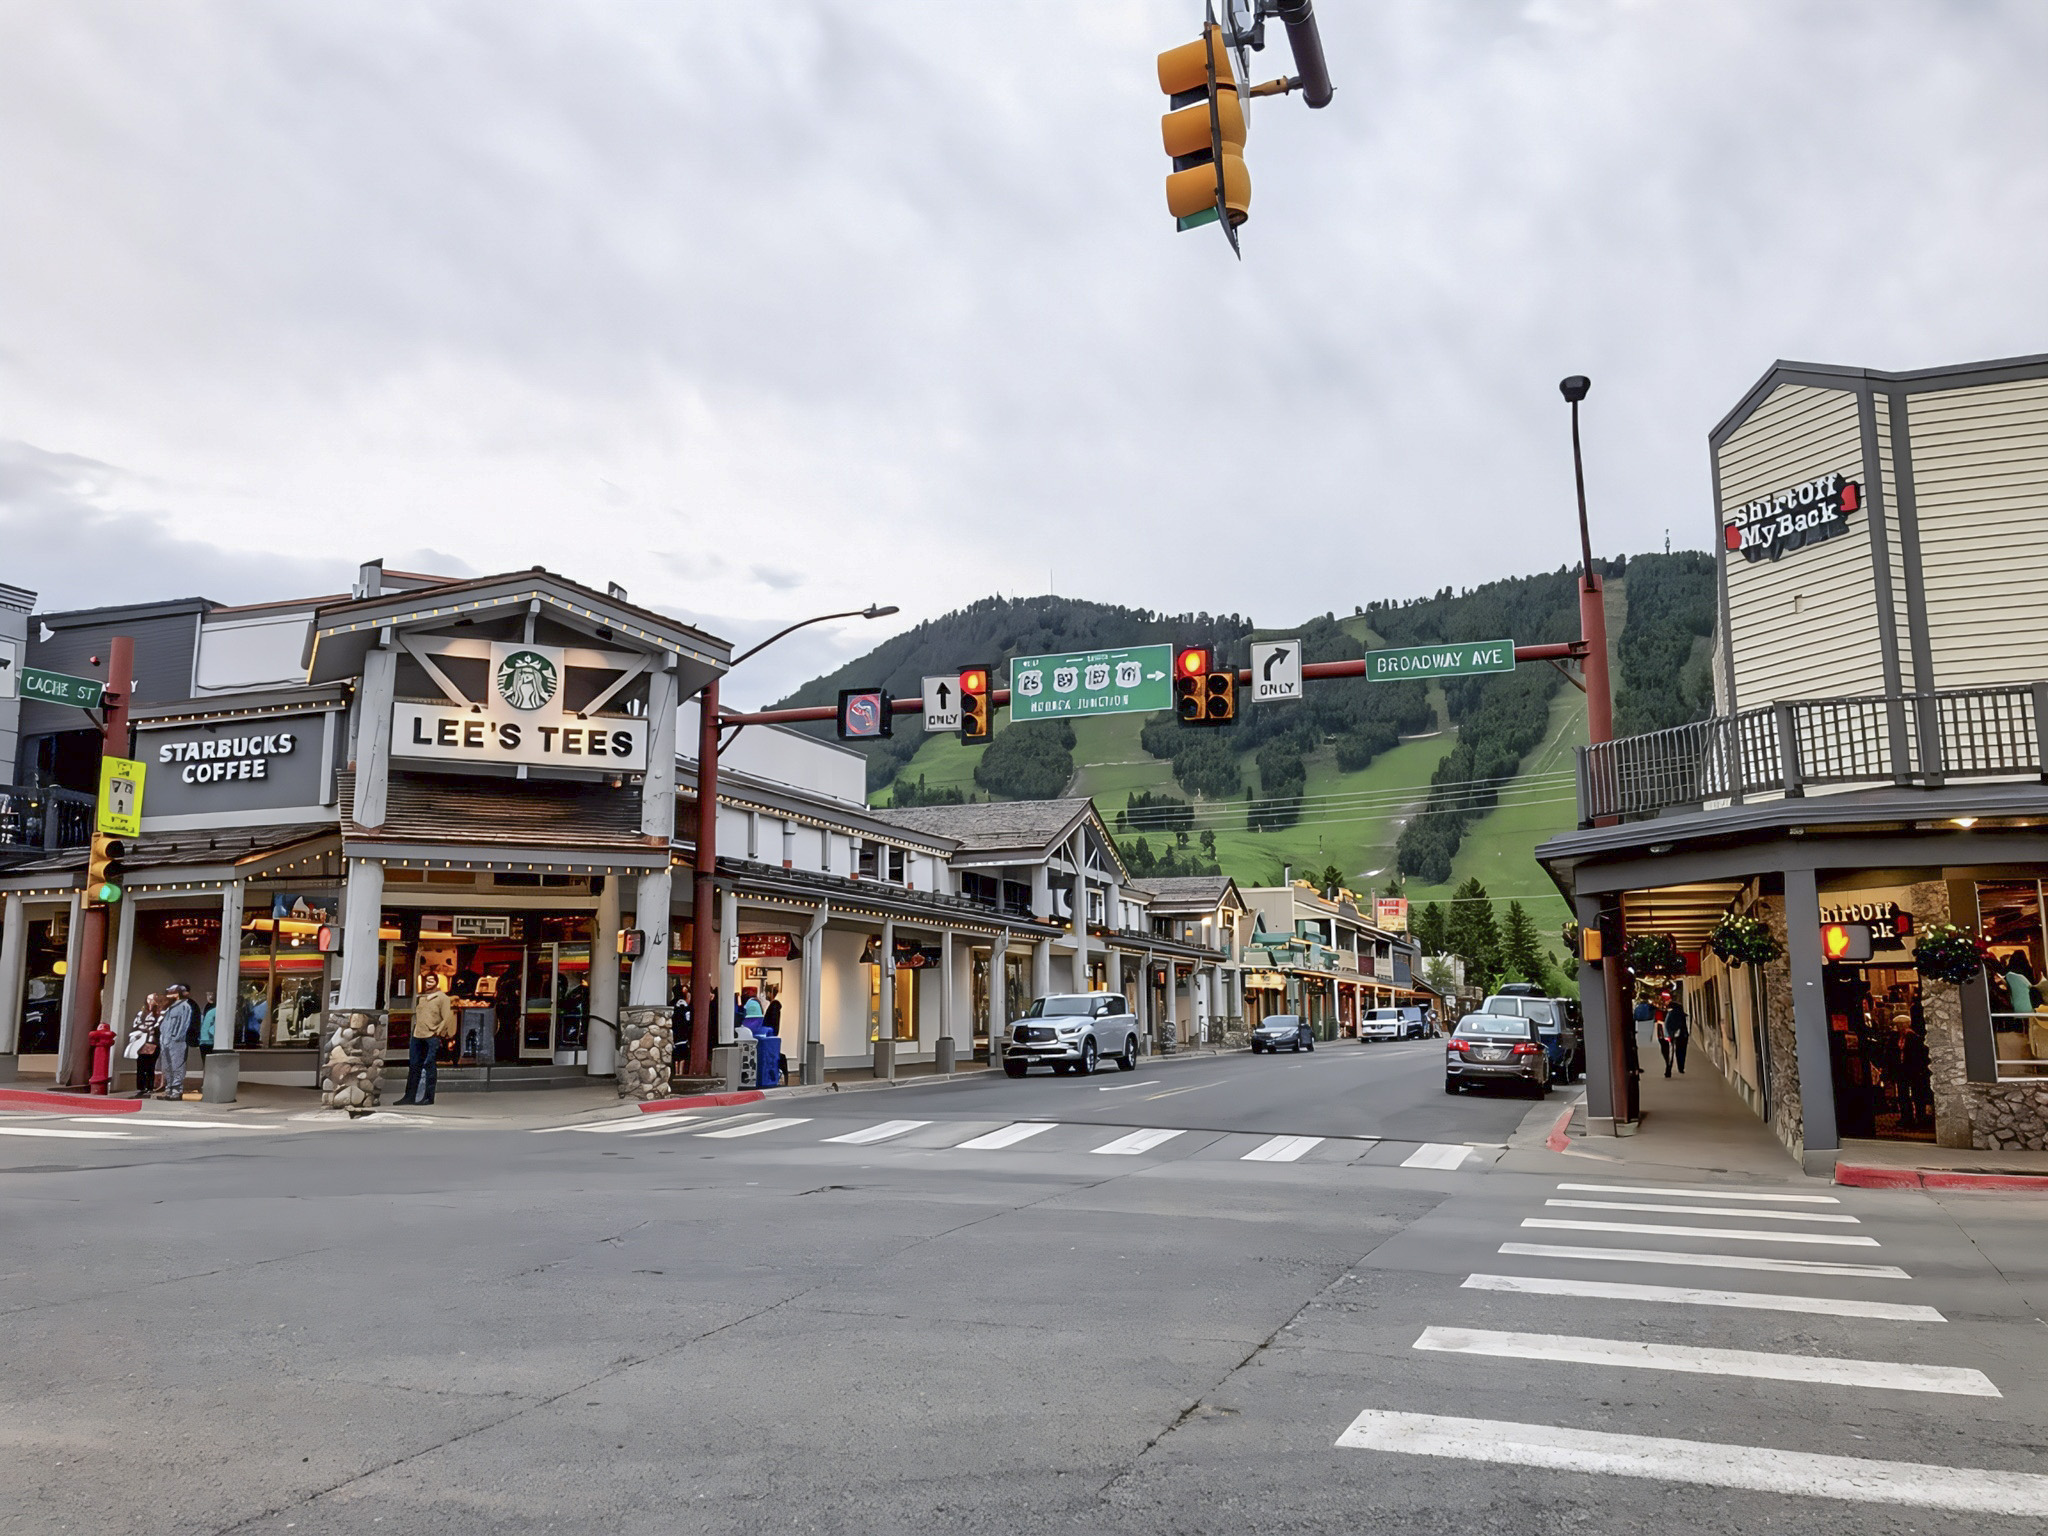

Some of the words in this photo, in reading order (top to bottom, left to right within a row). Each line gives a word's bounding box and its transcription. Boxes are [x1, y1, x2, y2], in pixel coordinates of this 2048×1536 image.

[1377, 651, 1462, 673] BROADWAY
[1472, 649, 1503, 666] AVE
[26, 676, 69, 697] CACHE
[77, 686, 96, 700] ST
[1057, 672, 1073, 687] 89
[1259, 682, 1295, 696] ONLY
[1077, 694, 1129, 710] JUNCTION
[928, 713, 959, 725] ONLY
[159, 733, 293, 763] STARBUCKS
[412, 717, 522, 750] LEE'S
[537, 726, 633, 758] TEES
[181, 758, 266, 784] COFFEE
